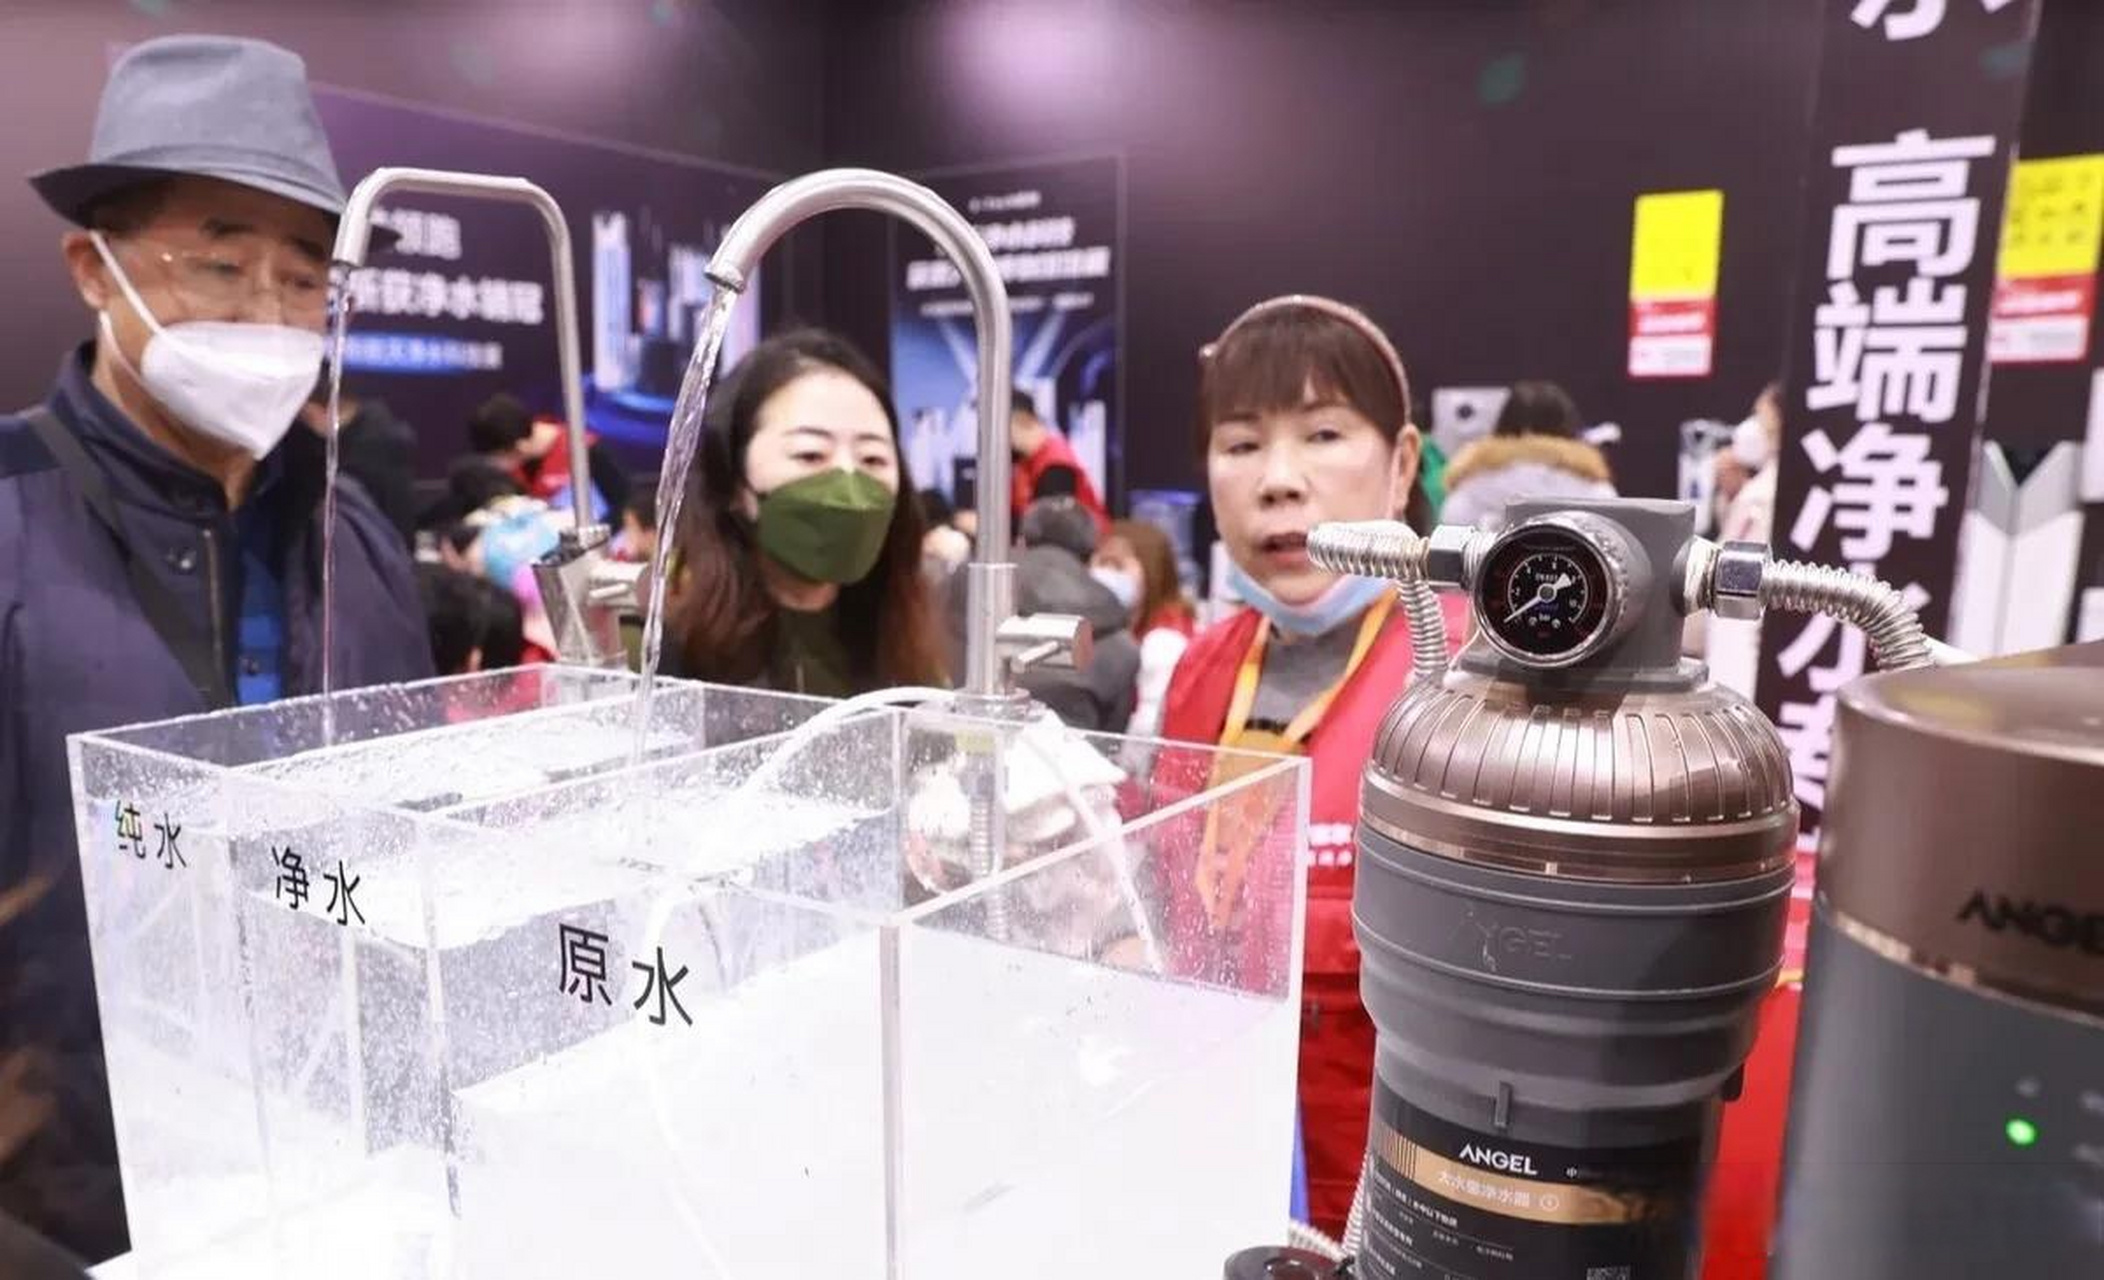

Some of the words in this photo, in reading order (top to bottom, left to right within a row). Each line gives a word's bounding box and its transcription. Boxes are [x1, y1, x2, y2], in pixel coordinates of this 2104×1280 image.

[114, 799, 188, 870] 纯水
[270, 846, 366, 926] 净水
[556, 923, 694, 1029] 原水
[1459, 1143, 1538, 1176] ANGEL
